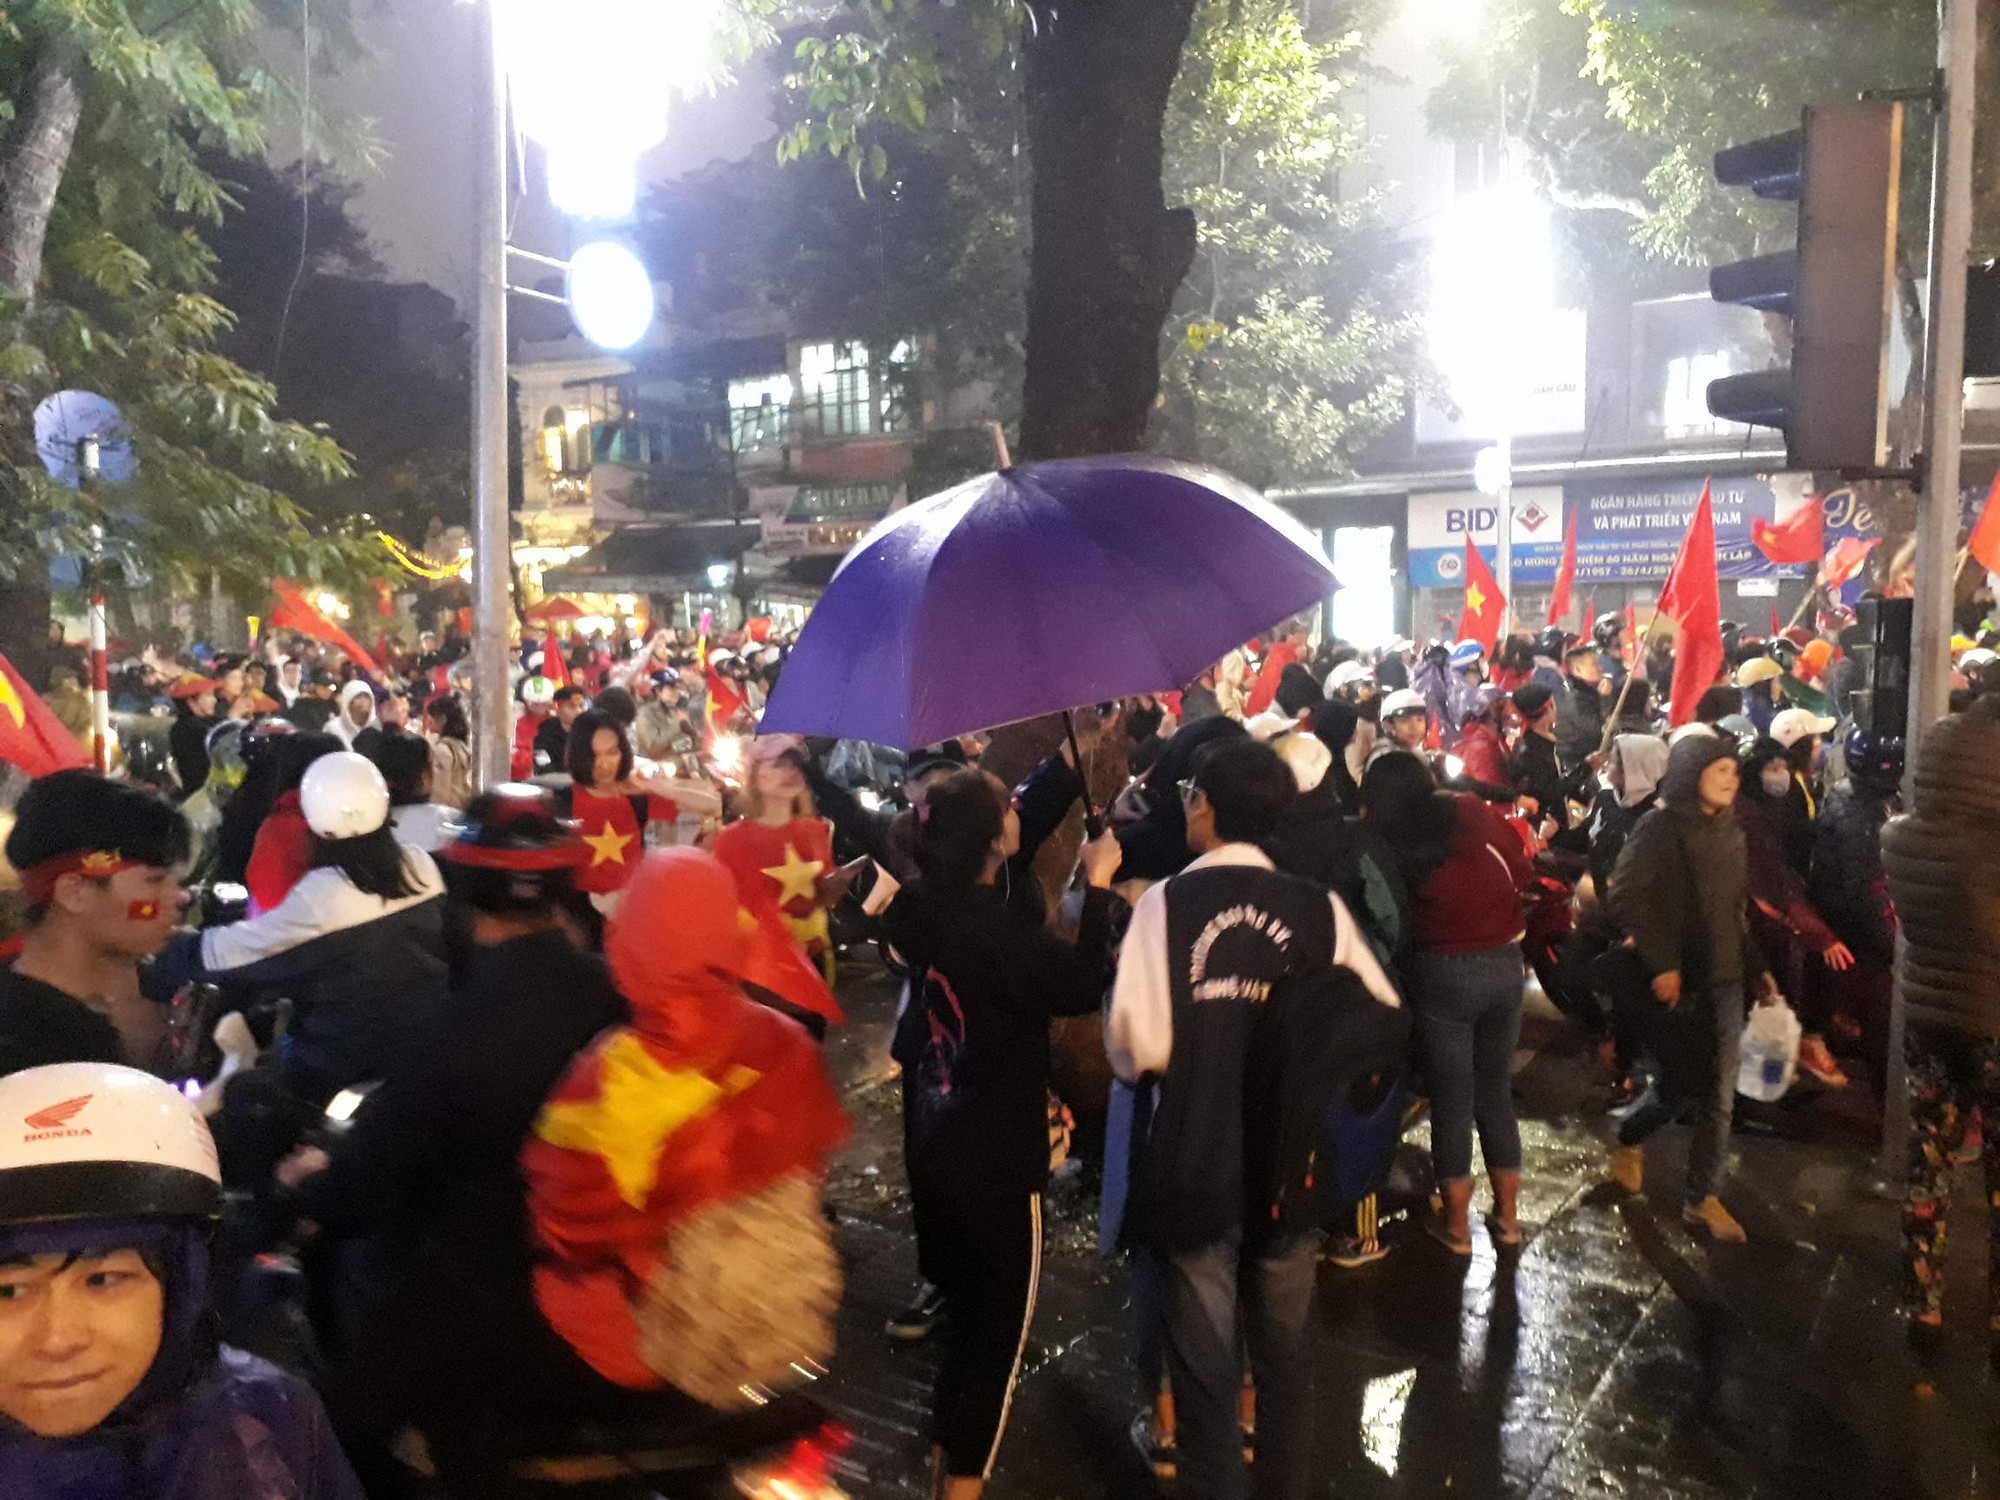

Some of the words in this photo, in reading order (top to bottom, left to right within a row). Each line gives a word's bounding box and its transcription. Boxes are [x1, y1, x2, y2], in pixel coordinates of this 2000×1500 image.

[1591, 494, 1624, 510] NGÂN
[1627, 492, 1662, 509] HÀNG
[1446, 506, 1515, 532] BID
[1593, 513, 1609, 530] VÀ
[1612, 511, 1642, 529] PHÁT
[1645, 508, 1680, 528] TRIỂN
[24, 1128, 93, 1142] HONDA
